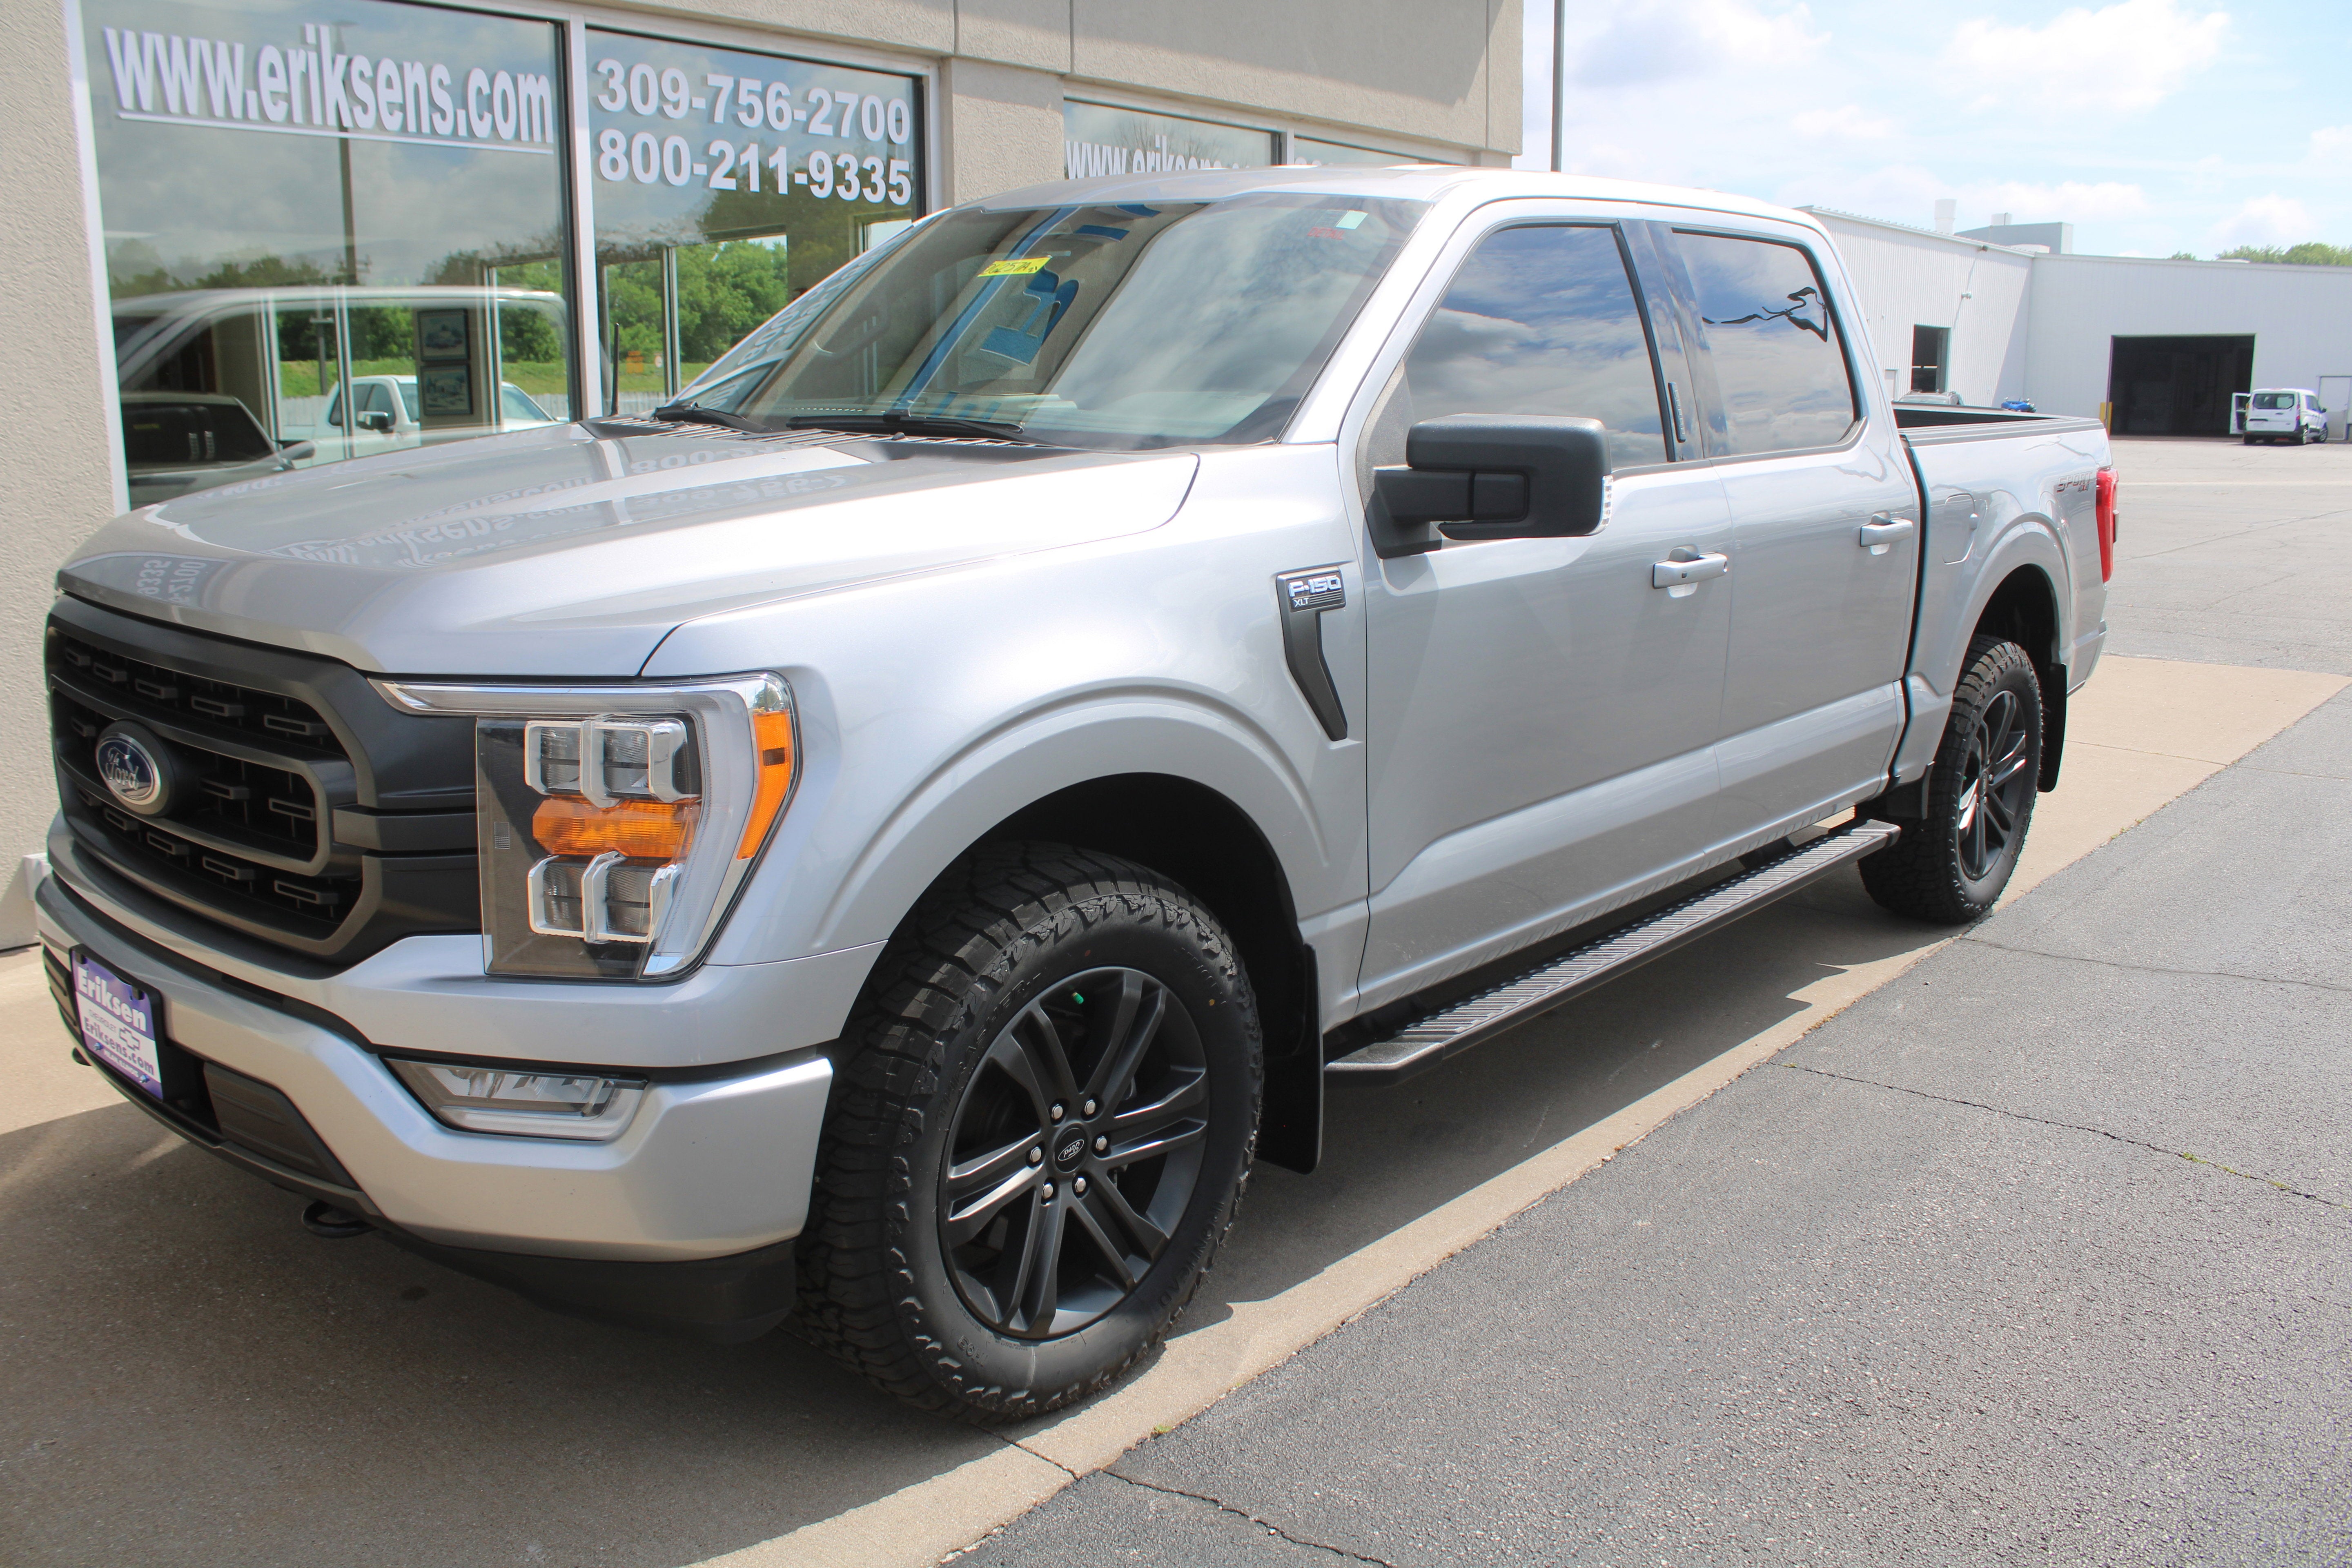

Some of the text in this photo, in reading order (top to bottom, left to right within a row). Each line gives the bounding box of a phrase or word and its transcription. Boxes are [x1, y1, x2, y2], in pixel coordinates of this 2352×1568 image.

[104, 22, 554, 145] www.eriksens.com
[597, 58, 910, 145] 309-756-2700
[599, 129, 911, 205] 800-211-9335
[1307, 227, 1345, 241] DETAIL
[2056, 471, 2093, 493] SPORT
[1288, 575, 1342, 597] F-150
[1294, 597, 1310, 607] XLT
[105, 746, 139, 791] Ford
[77, 966, 147, 1032] Eriksen
[84, 1016, 154, 1076] Eriksens.com
[1063, 1141, 1080, 1158] Ford
